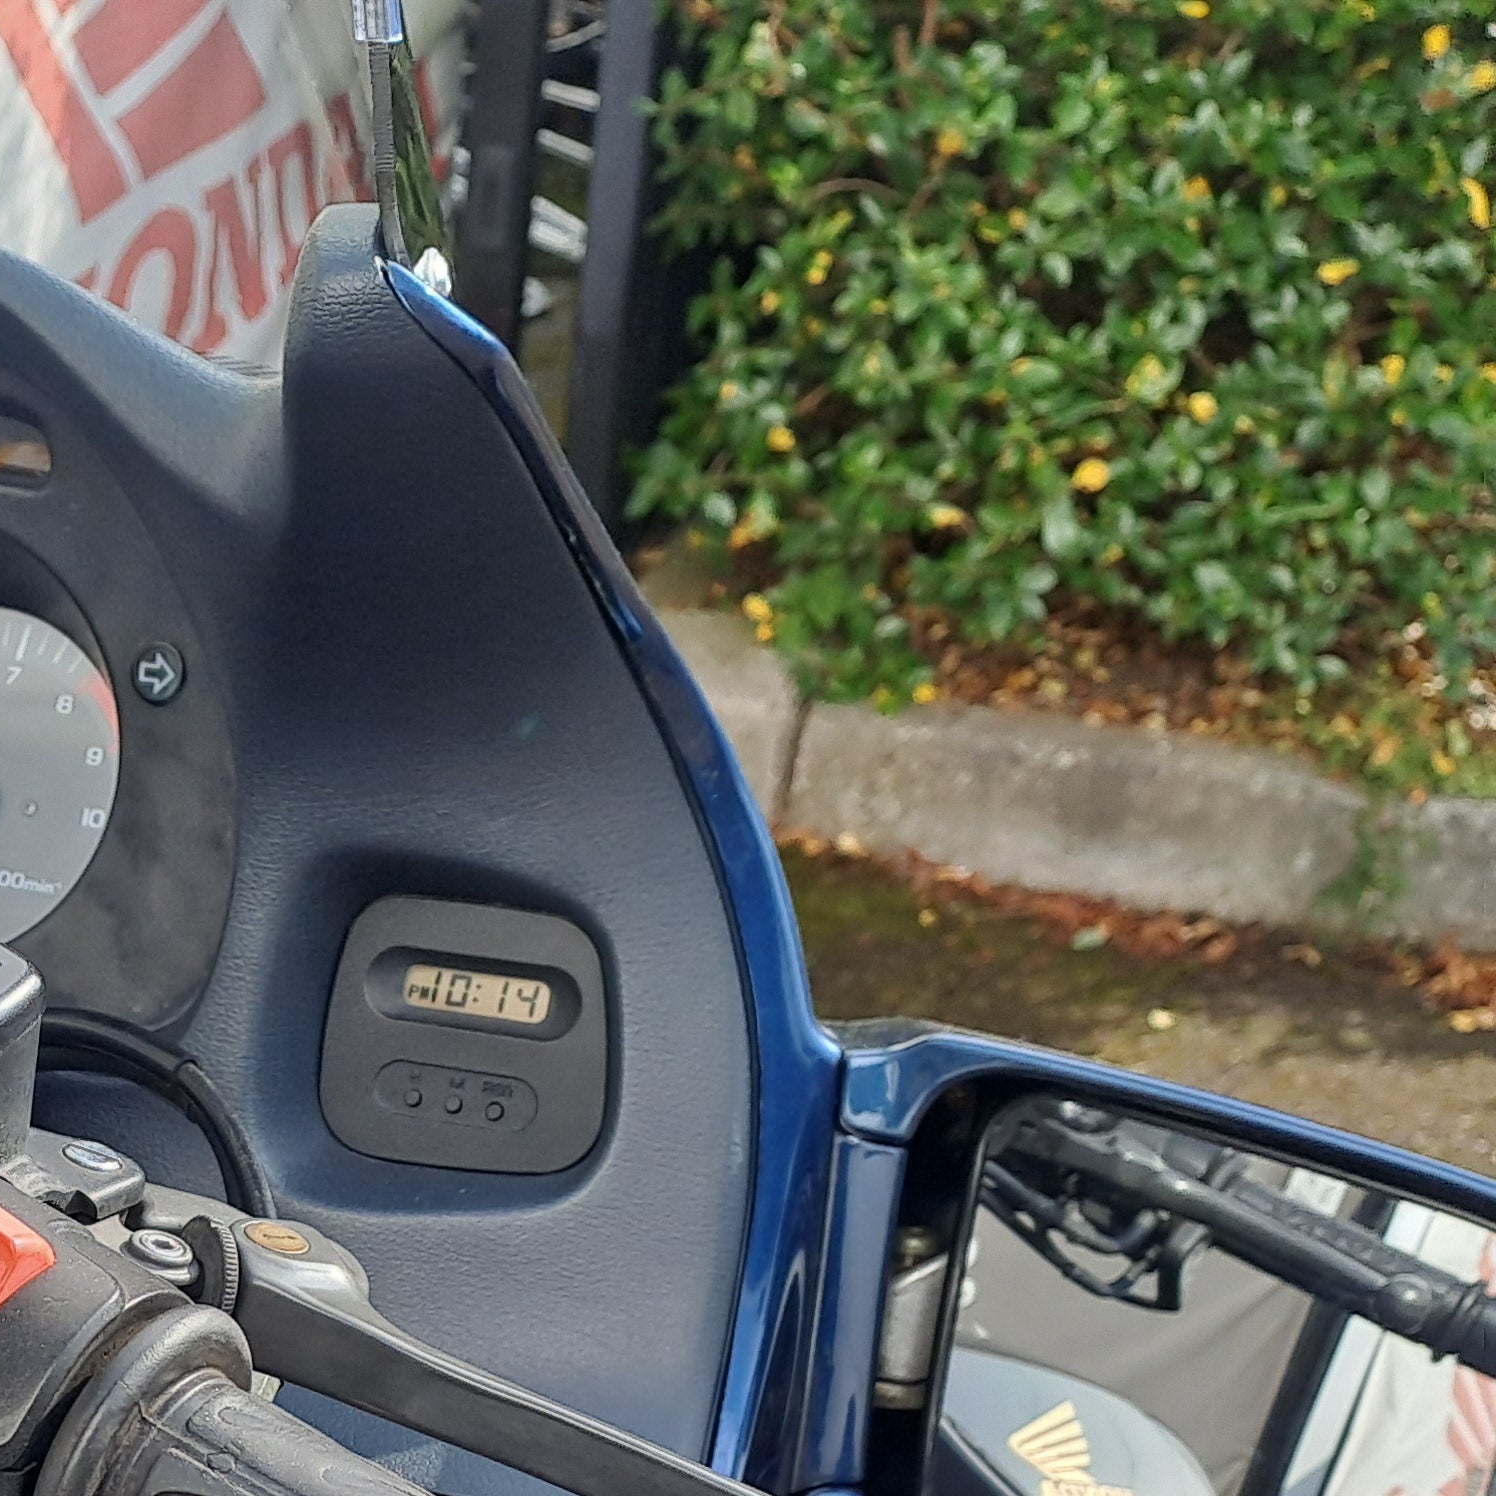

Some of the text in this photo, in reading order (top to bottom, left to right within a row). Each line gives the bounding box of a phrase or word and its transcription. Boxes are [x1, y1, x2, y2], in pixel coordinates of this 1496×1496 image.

[6, 666, 22, 686] 7
[54, 695, 74, 715] 8
[85, 747, 104, 766] 9
[80, 808, 106, 829] 10
[431, 970, 541, 1018] 10:14
